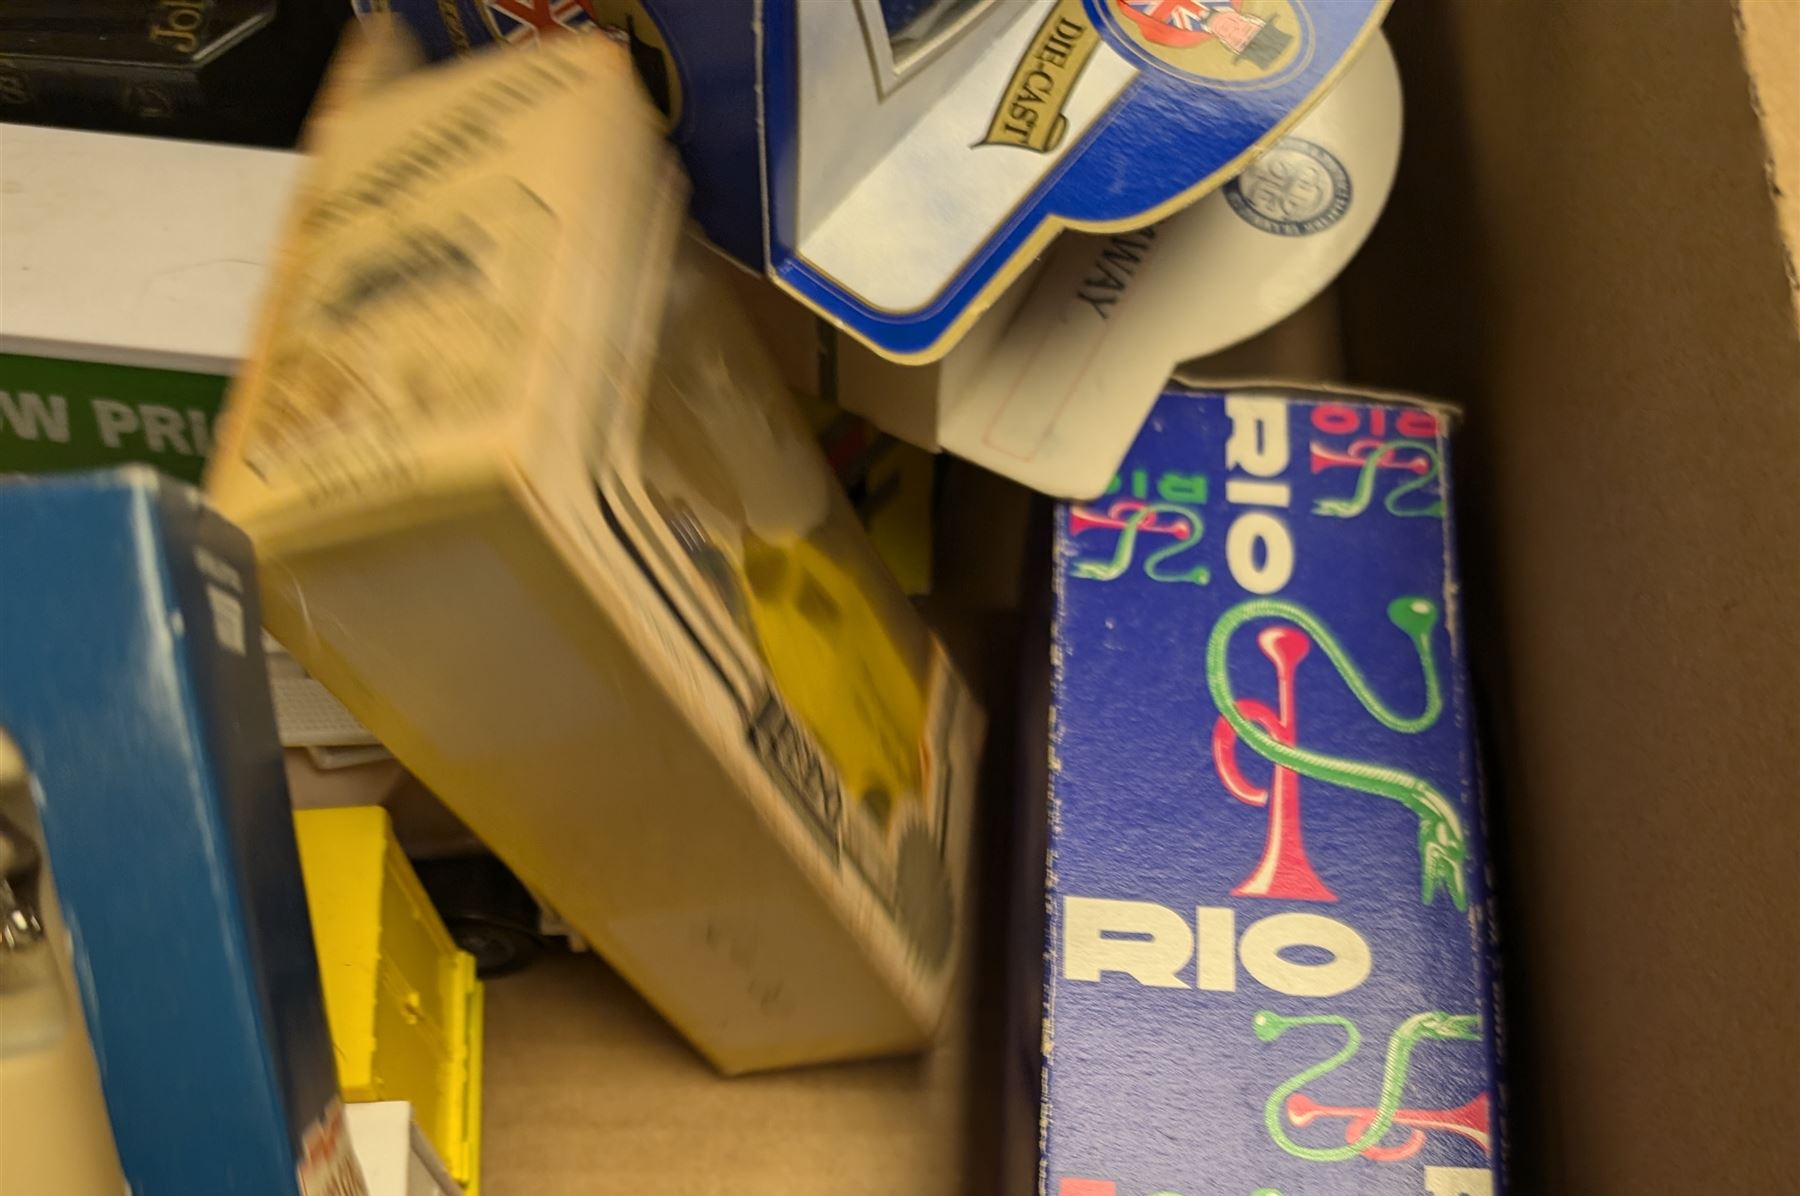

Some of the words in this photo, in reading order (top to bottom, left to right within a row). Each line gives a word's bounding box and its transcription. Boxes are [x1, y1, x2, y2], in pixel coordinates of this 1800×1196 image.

[1001, 16, 1086, 146] DIE-CAST
[1312, 404, 1442, 437] RIO
[1105, 468, 1207, 504] RI
[1225, 395, 1295, 594] RIO
[1063, 896, 1372, 997] RIO
